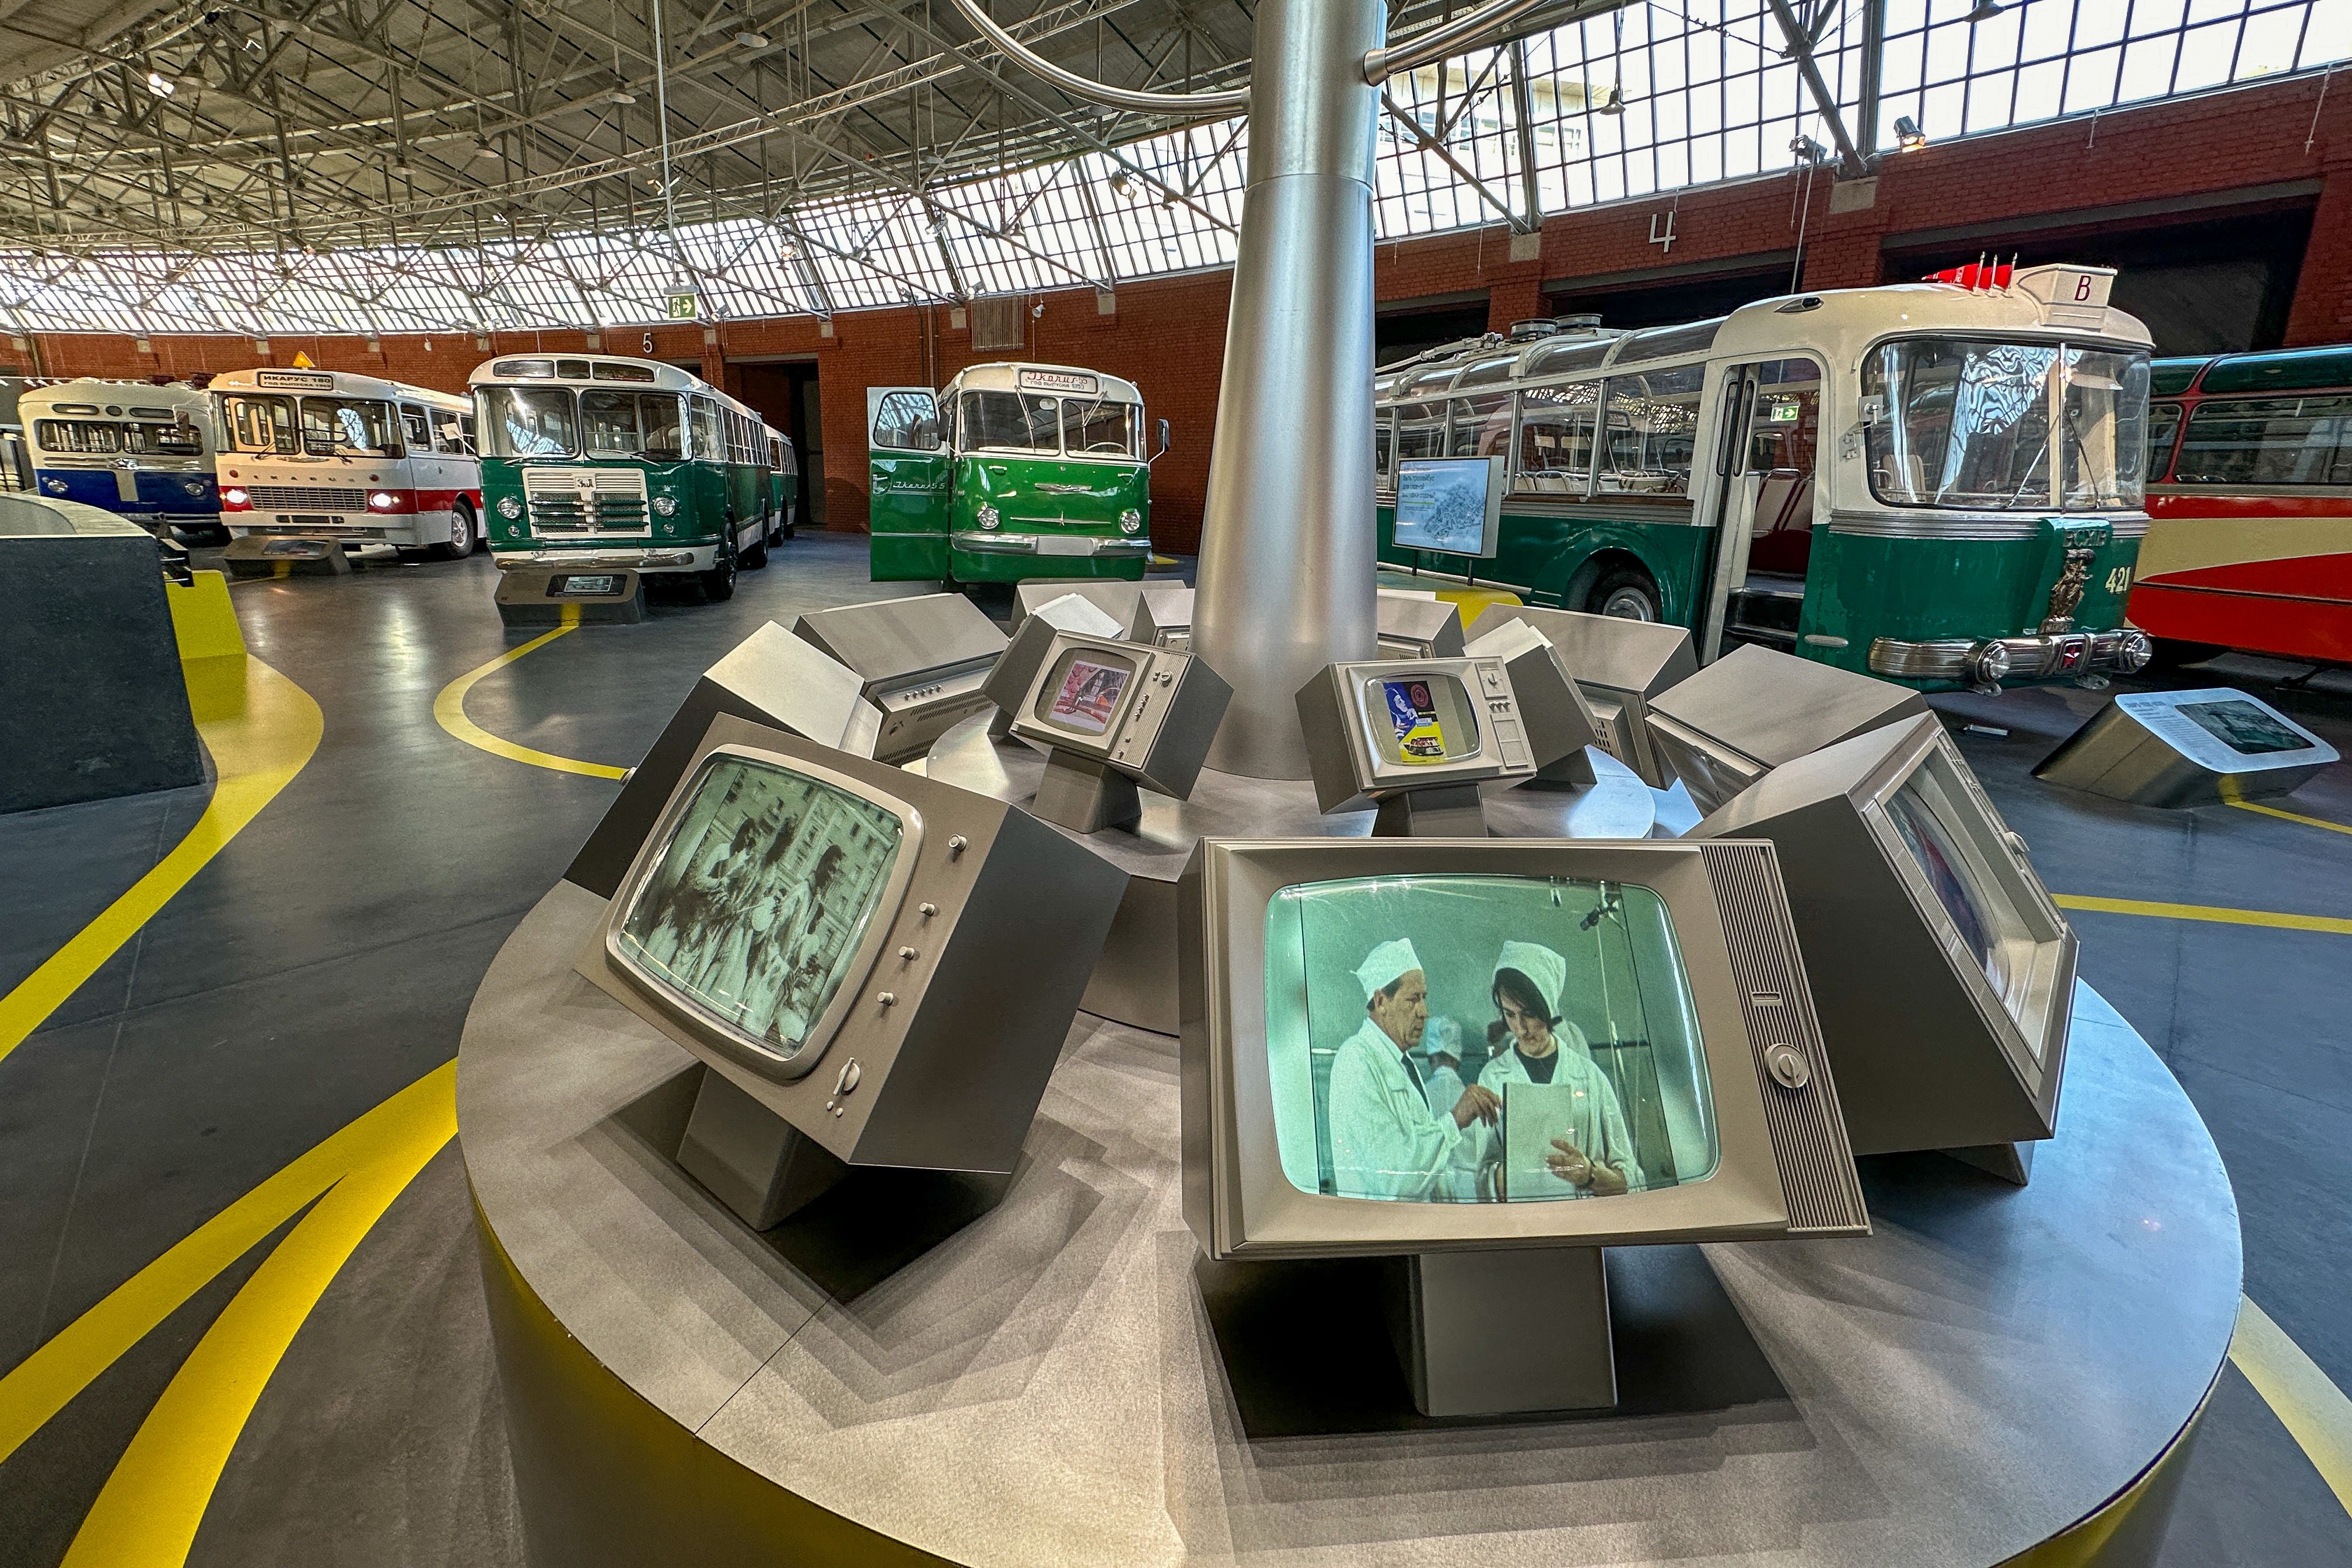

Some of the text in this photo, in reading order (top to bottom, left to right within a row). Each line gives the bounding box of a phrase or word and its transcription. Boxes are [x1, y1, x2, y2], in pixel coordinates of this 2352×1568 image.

[1649, 211, 1676, 253] 4
[2074, 275, 2092, 301] В
[643, 332, 653, 354] 5
[2105, 566, 2131, 593] 421
